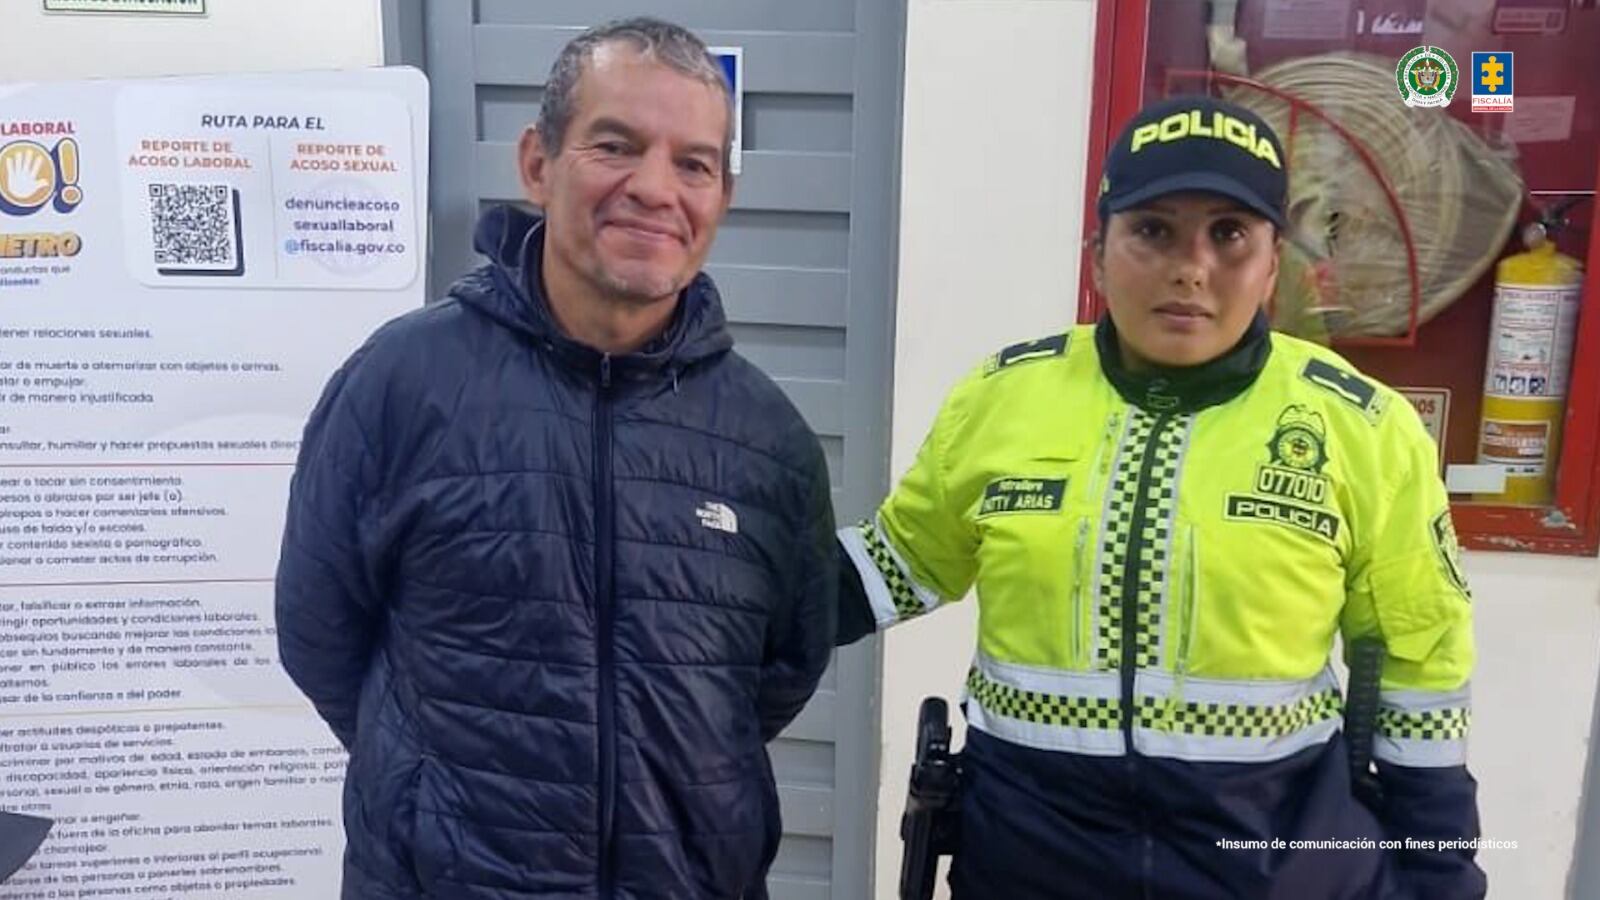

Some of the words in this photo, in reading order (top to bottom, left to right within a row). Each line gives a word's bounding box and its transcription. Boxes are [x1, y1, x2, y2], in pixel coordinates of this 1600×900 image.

[1, 122, 75, 135] LABORAL
[201, 115, 247, 128] RUTA
[252, 116, 300, 129] PARA
[305, 117, 325, 130] EL
[141, 140, 208, 152] REPORTE
[213, 141, 232, 152] DE
[297, 144, 361, 155] REPORTE
[366, 145, 384, 155] DE
[128, 154, 179, 167] ACOSO
[183, 157, 252, 168] LABORAL
[290, 160, 340, 171] ACOSO
[344, 160, 398, 172] SEXUAL
[285, 197, 400, 212] denuncieacoso
[294, 219, 394, 232] sexuallaboral
[1259, 468, 1327, 503] 077010
[1014, 494, 1054, 509] ARIAS
